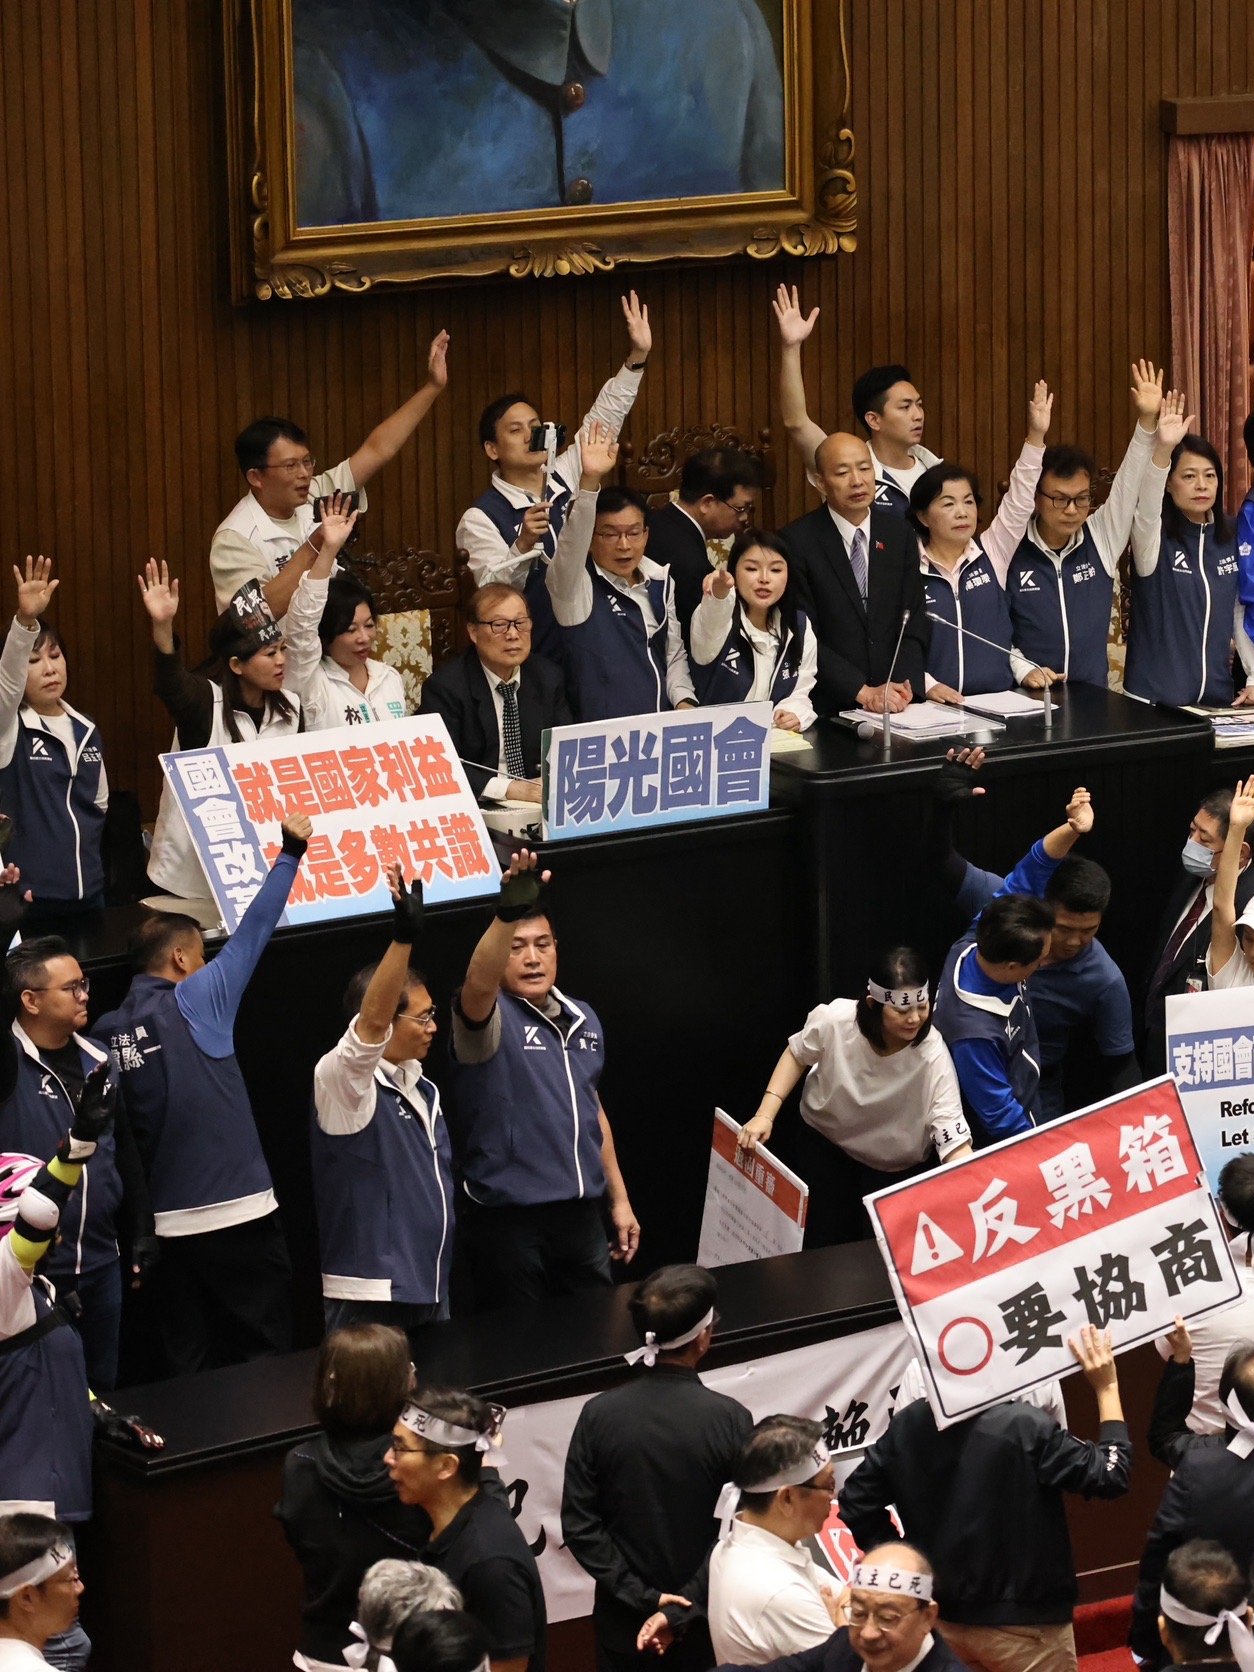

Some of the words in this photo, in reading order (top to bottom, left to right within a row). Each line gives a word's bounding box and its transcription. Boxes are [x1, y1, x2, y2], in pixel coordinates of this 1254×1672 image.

[231, 735, 462, 825] 就是國家利益
[555, 716, 767, 828] 陽光國會
[970, 1113, 1190, 1264] 反黑箱
[1221, 1130, 1249, 1147] Let
[997, 1218, 1224, 1367] 要協商
